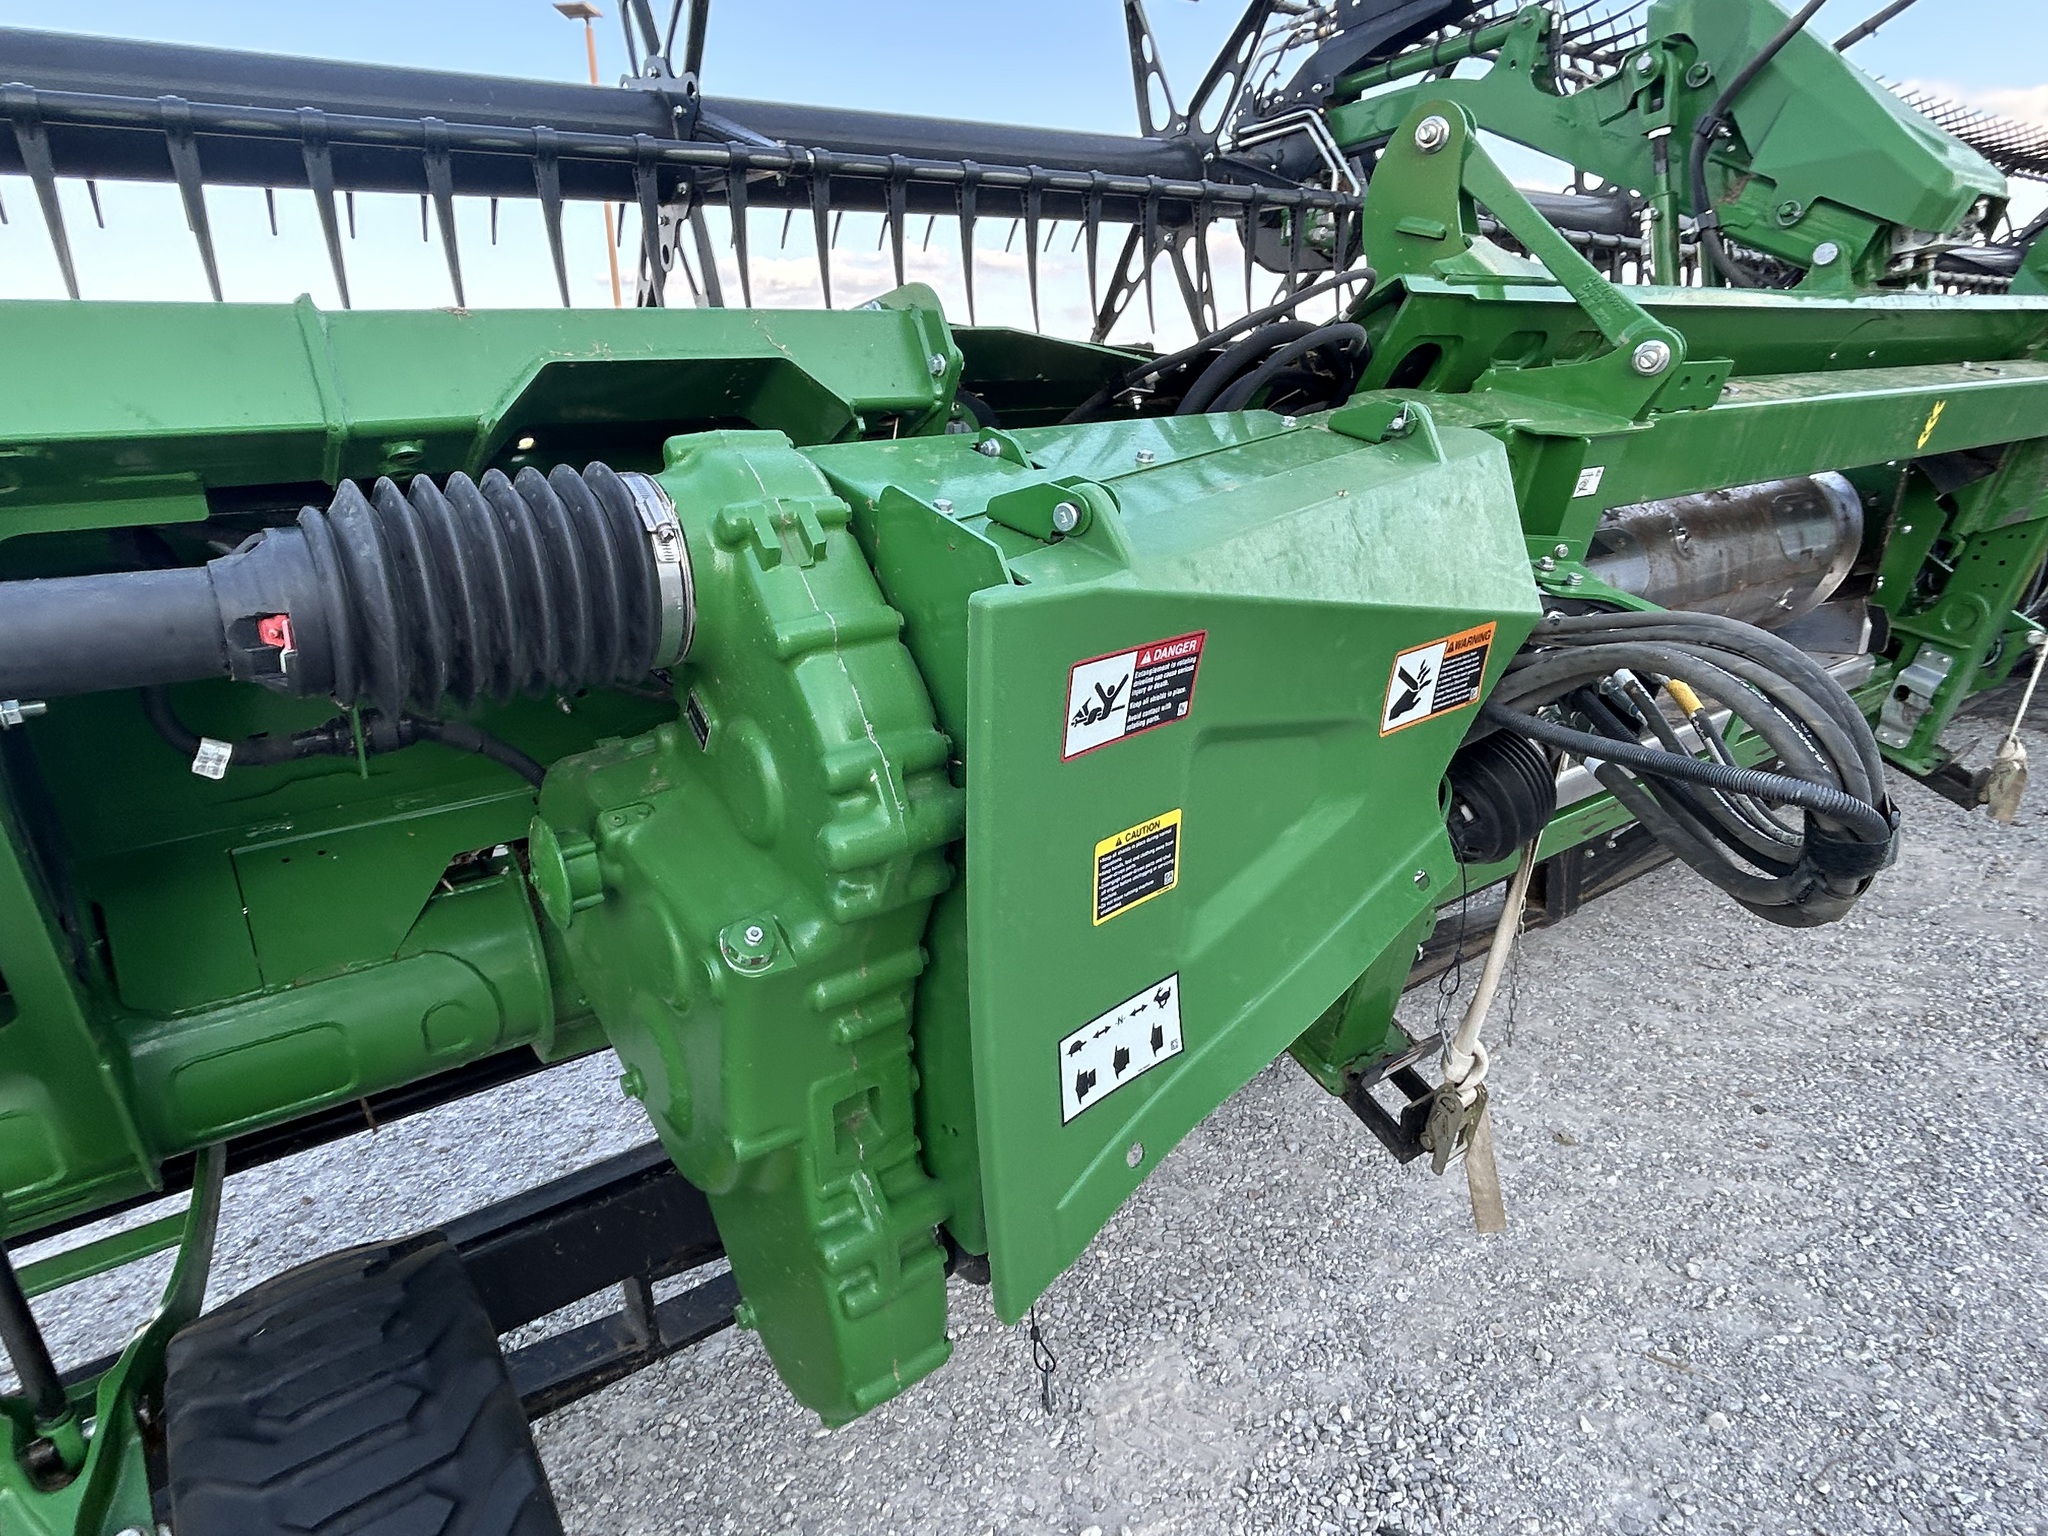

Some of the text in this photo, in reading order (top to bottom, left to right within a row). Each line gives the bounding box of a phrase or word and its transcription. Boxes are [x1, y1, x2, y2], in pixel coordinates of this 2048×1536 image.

[1154, 640, 1197, 661] DANGER
[1455, 631, 1491, 650] WARNING
[1135, 663, 1169, 678] Entanglement
[1177, 657, 1196, 666] rotating
[1130, 701, 1141, 709] Keep
[1150, 693, 1166, 702] shields
[1172, 687, 1186, 696] place.
[1132, 687, 1146, 696] injury
[1154, 680, 1168, 689] death.
[1126, 715, 1160, 730] rotating parts.
[1128, 712, 1141, 722] Avoid
[1142, 706, 1160, 717] contact
[1125, 820, 1160, 842] CAUTION
